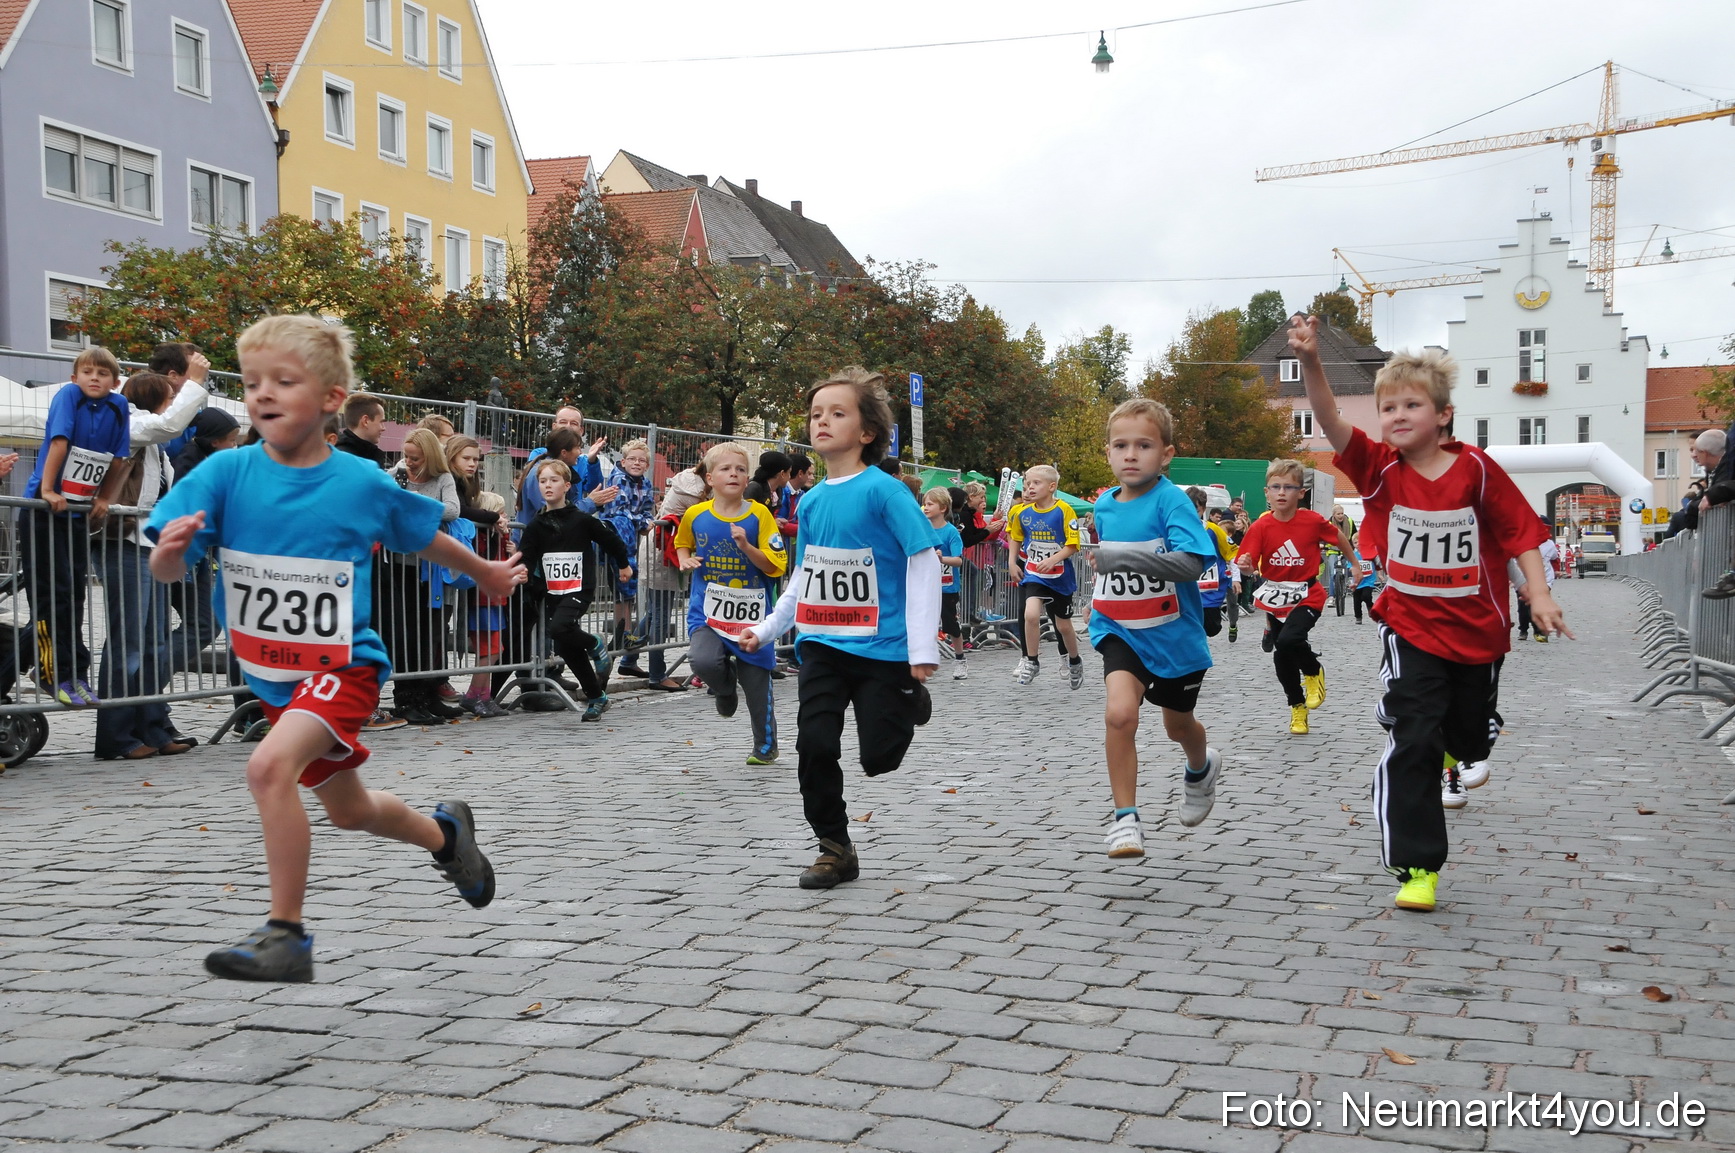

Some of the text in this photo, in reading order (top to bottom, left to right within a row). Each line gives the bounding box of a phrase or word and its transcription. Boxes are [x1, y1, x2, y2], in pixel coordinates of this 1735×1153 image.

[912, 377, 920, 402] P
[72, 460, 108, 484] 708
[1392, 511, 1466, 528] PARTL Neumarkt
[1397, 527, 1472, 564] 7115
[819, 556, 860, 567] Neumarkt
[1030, 548, 1060, 562] 751
[1268, 556, 1306, 567] adidas
[223, 561, 331, 585] PARTL Neumarkt
[546, 562, 579, 579] 7564
[1200, 568, 1214, 580] 21
[1410, 570, 1454, 585] Jannik
[803, 566, 870, 602] 7160
[707, 587, 756, 600] PARTL Neumarkt
[233, 582, 339, 638] 7230
[711, 596, 761, 621] 7068
[805, 608, 861, 625] Christoph
[259, 644, 302, 666] Felix
